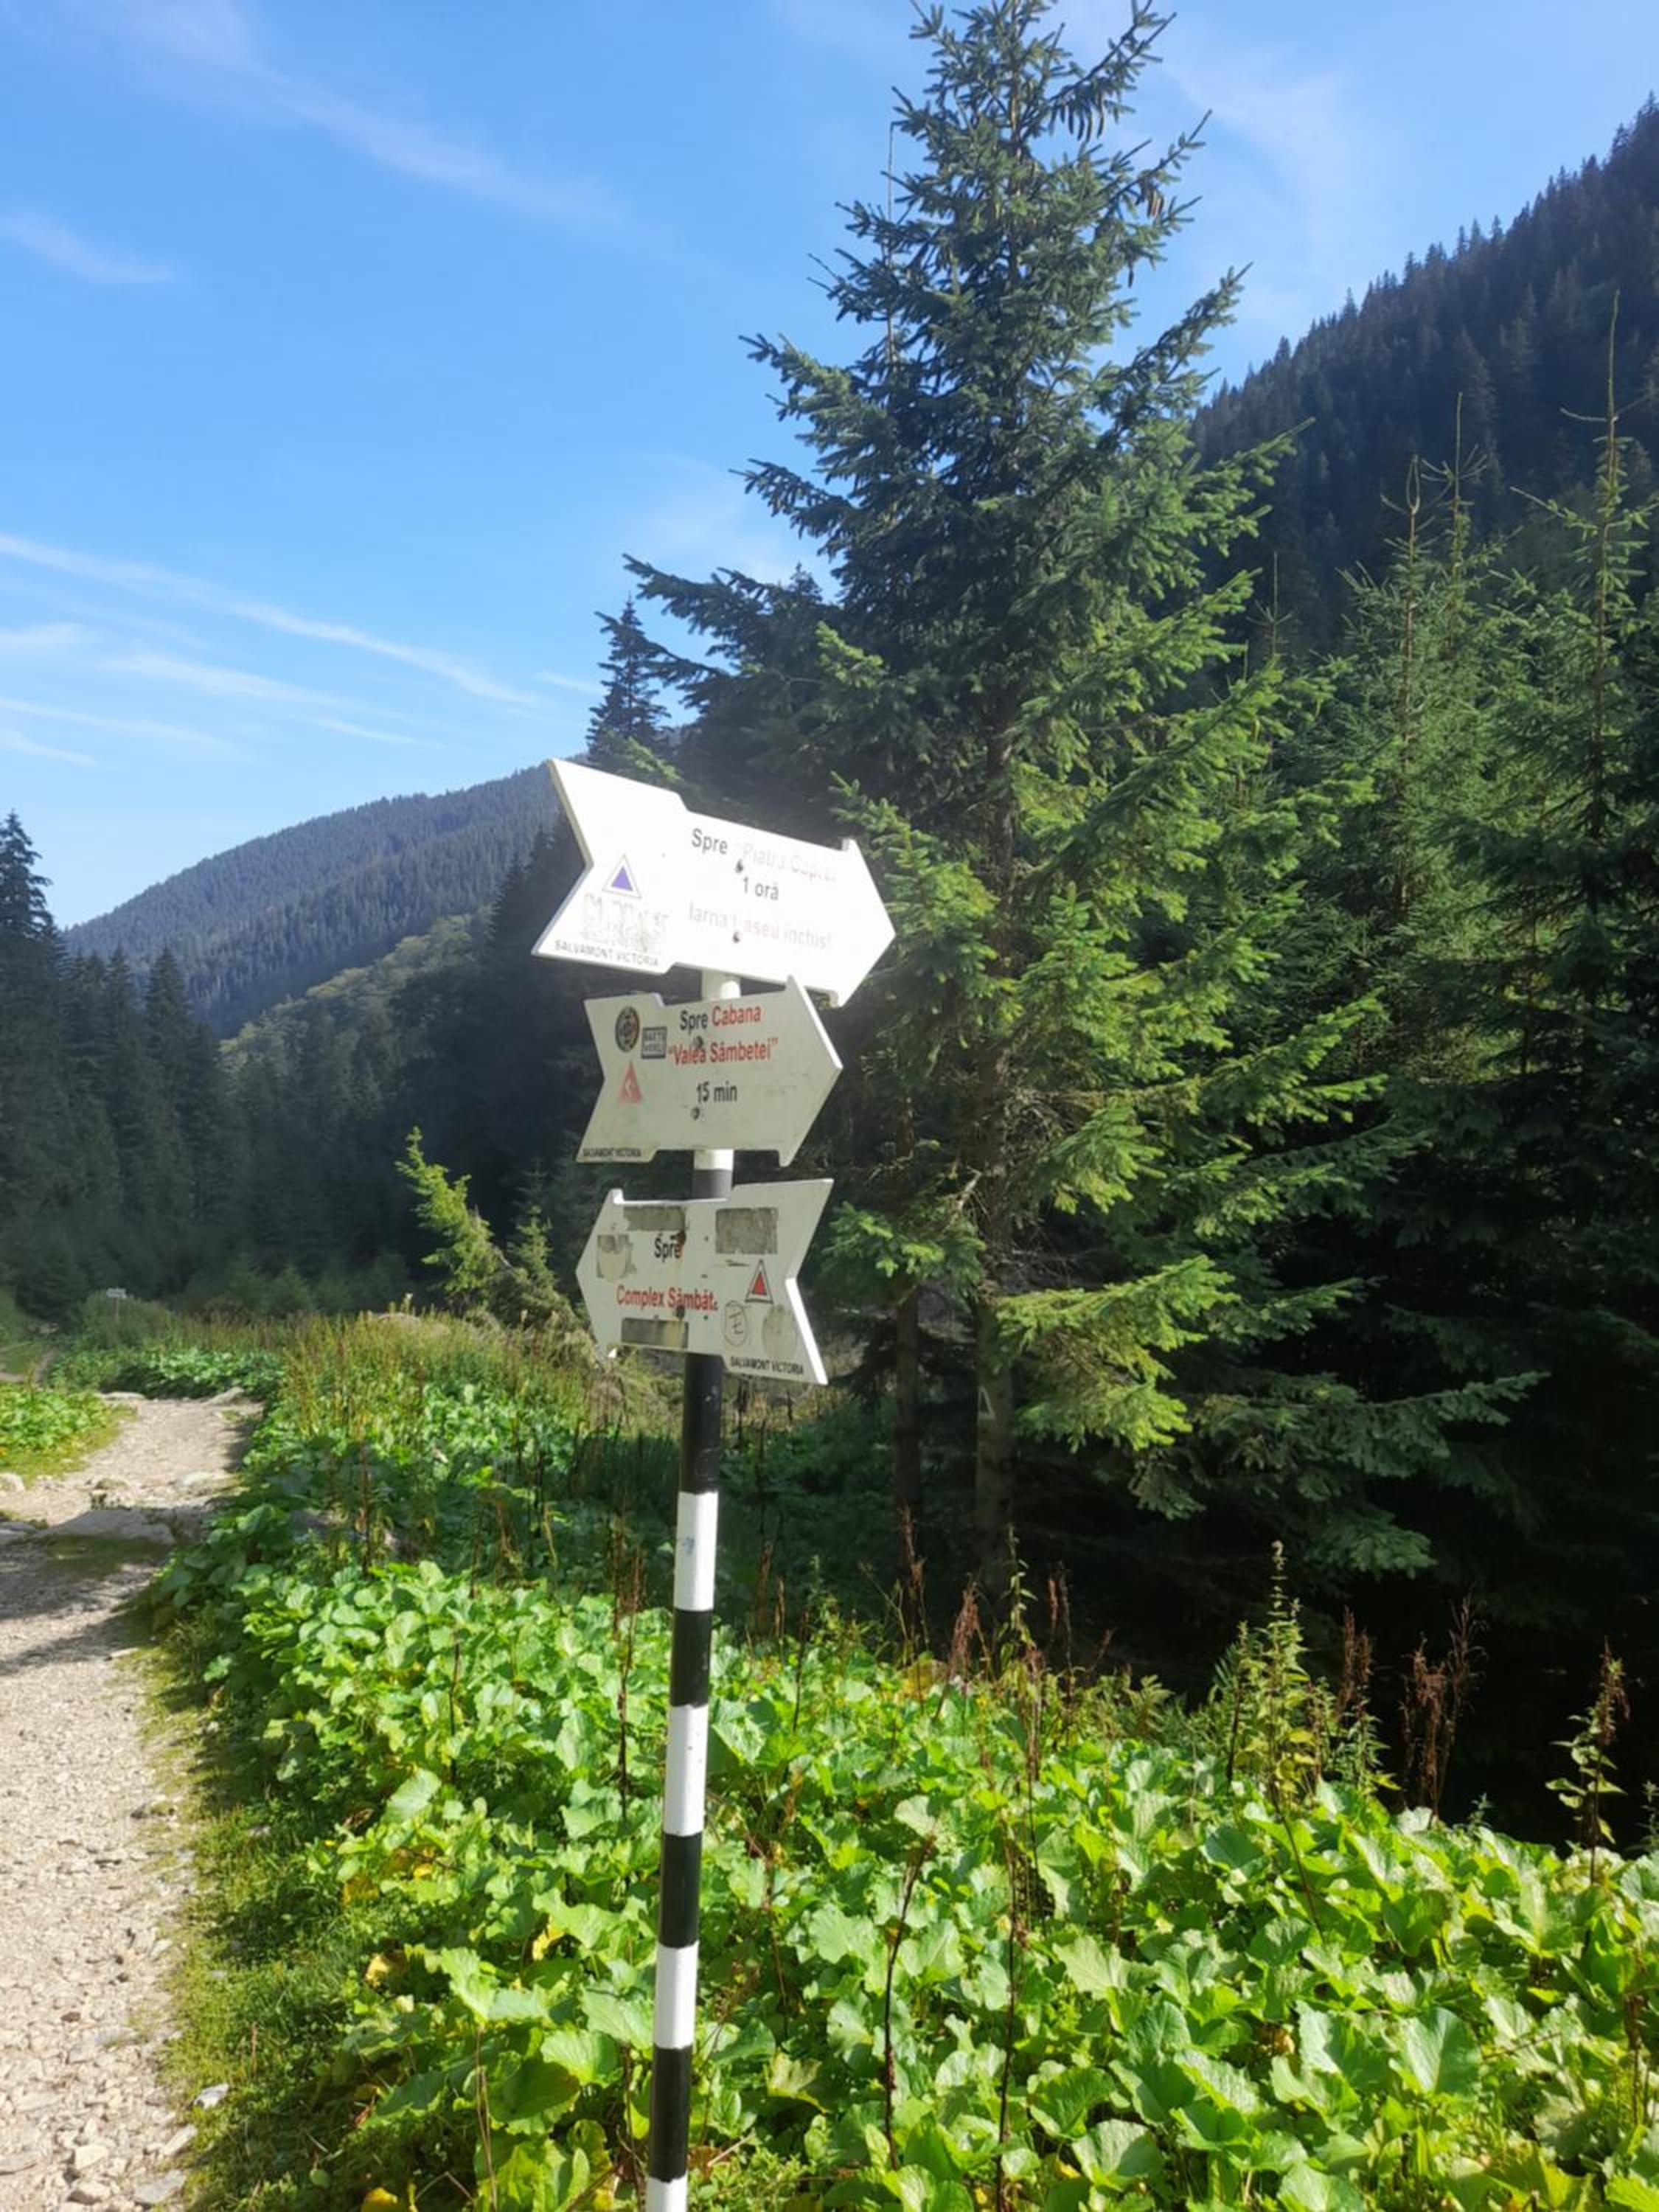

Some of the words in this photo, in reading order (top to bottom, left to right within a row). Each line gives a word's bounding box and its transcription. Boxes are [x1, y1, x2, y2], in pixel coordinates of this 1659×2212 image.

[692, 827, 728, 855] Spre
[742, 875, 749, 894] 1
[688, 901, 728, 928] Iarna
[680, 1009, 709, 1035] Spre
[712, 1005, 762, 1027] Cabana
[696, 1081, 709, 1104] 15
[714, 1080, 738, 1102] min
[654, 1237, 682, 1262] Spre
[616, 1284, 664, 1310] Complex
[771, 1361, 804, 1375] VICTORIA
